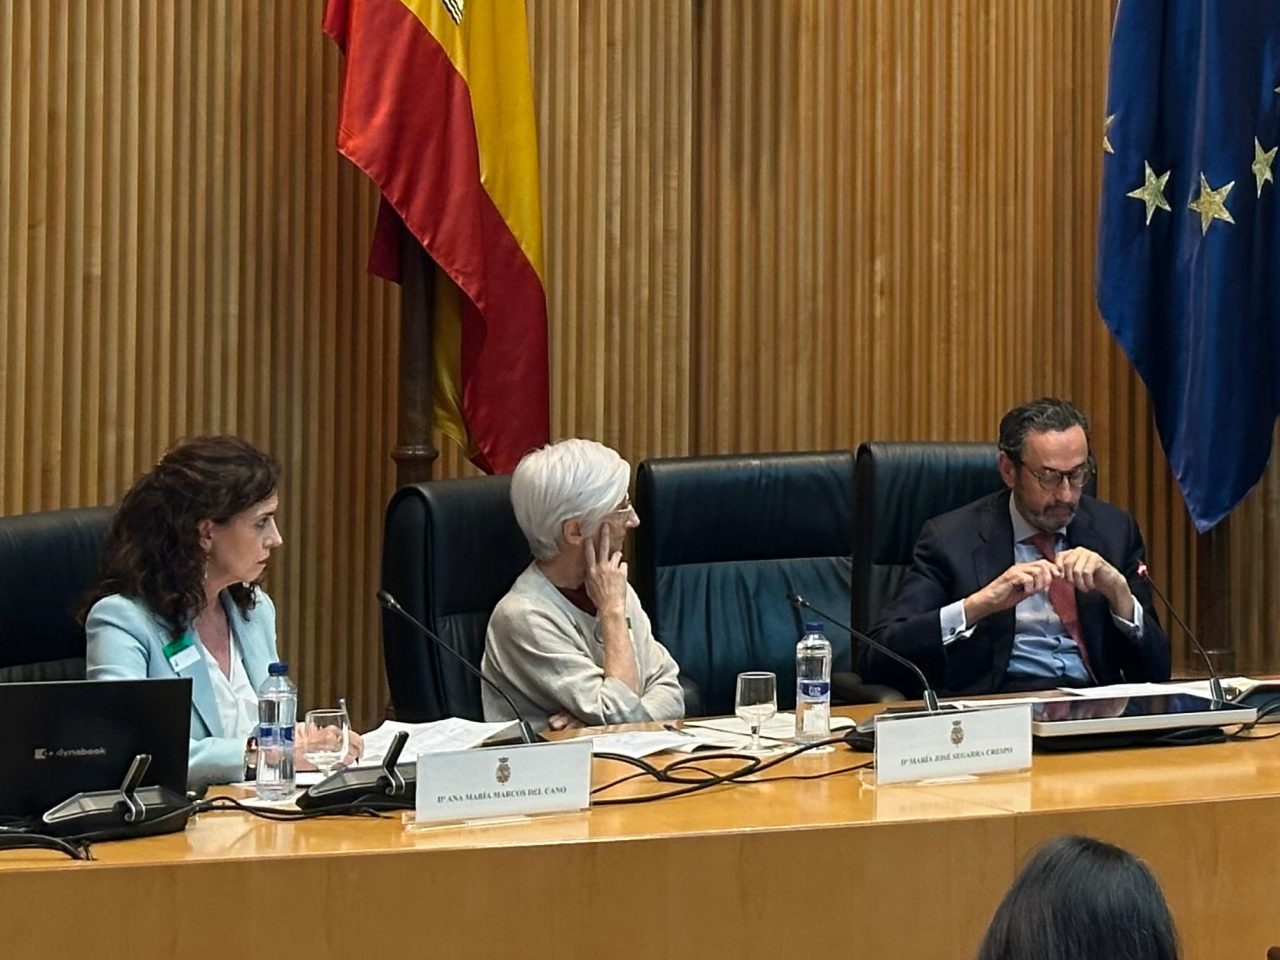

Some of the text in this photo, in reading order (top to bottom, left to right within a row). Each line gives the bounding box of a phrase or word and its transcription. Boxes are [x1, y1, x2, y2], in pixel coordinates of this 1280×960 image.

[910, 755, 933, 765] MARÍA
[447, 794, 464, 802] ANA
[465, 791, 492, 800] MARÍA
[493, 790, 526, 798] MARCOS
[528, 788, 542, 796] DEL
[544, 786, 567, 795] CANO
